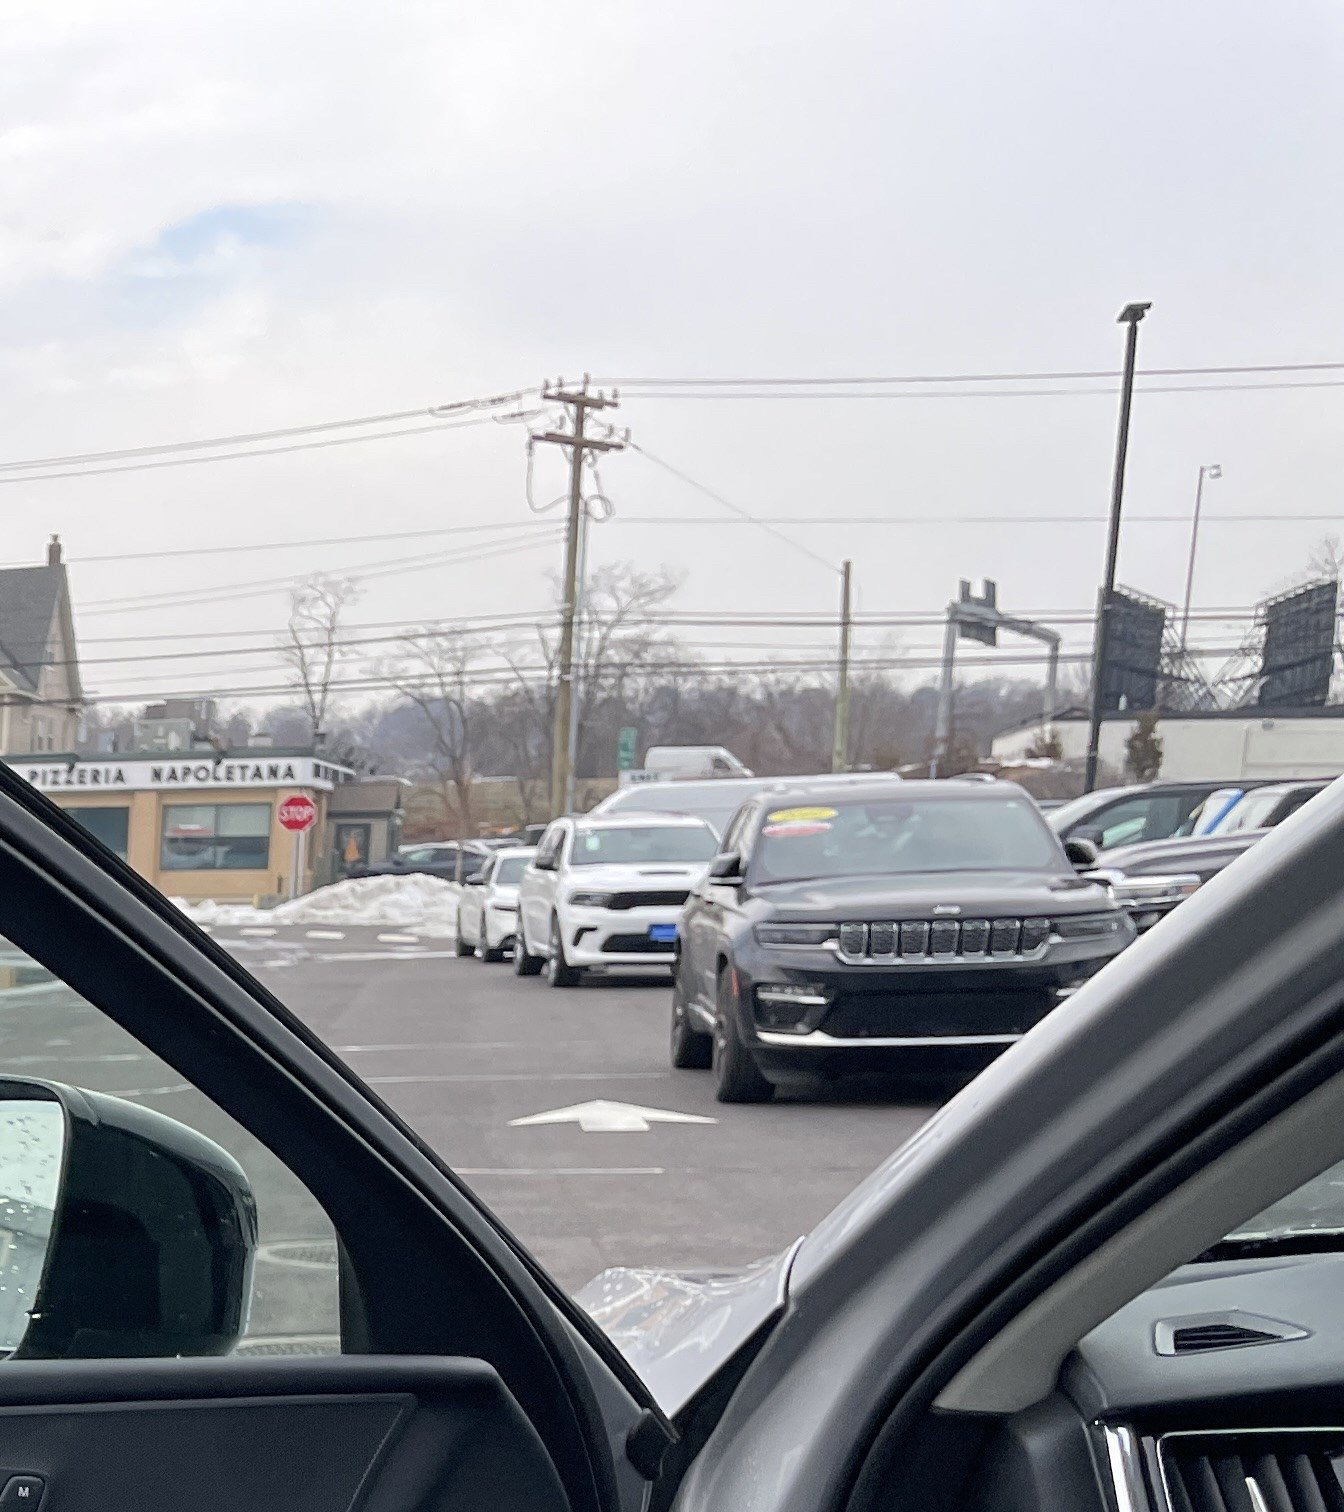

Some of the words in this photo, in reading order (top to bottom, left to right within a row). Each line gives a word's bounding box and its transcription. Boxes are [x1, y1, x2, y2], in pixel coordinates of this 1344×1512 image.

[28, 767, 126, 786] PIZZERIA
[150, 763, 295, 783] NAPOLETANA
[280, 805, 314, 821] STOP
[18, 1486, 30, 1498] M
